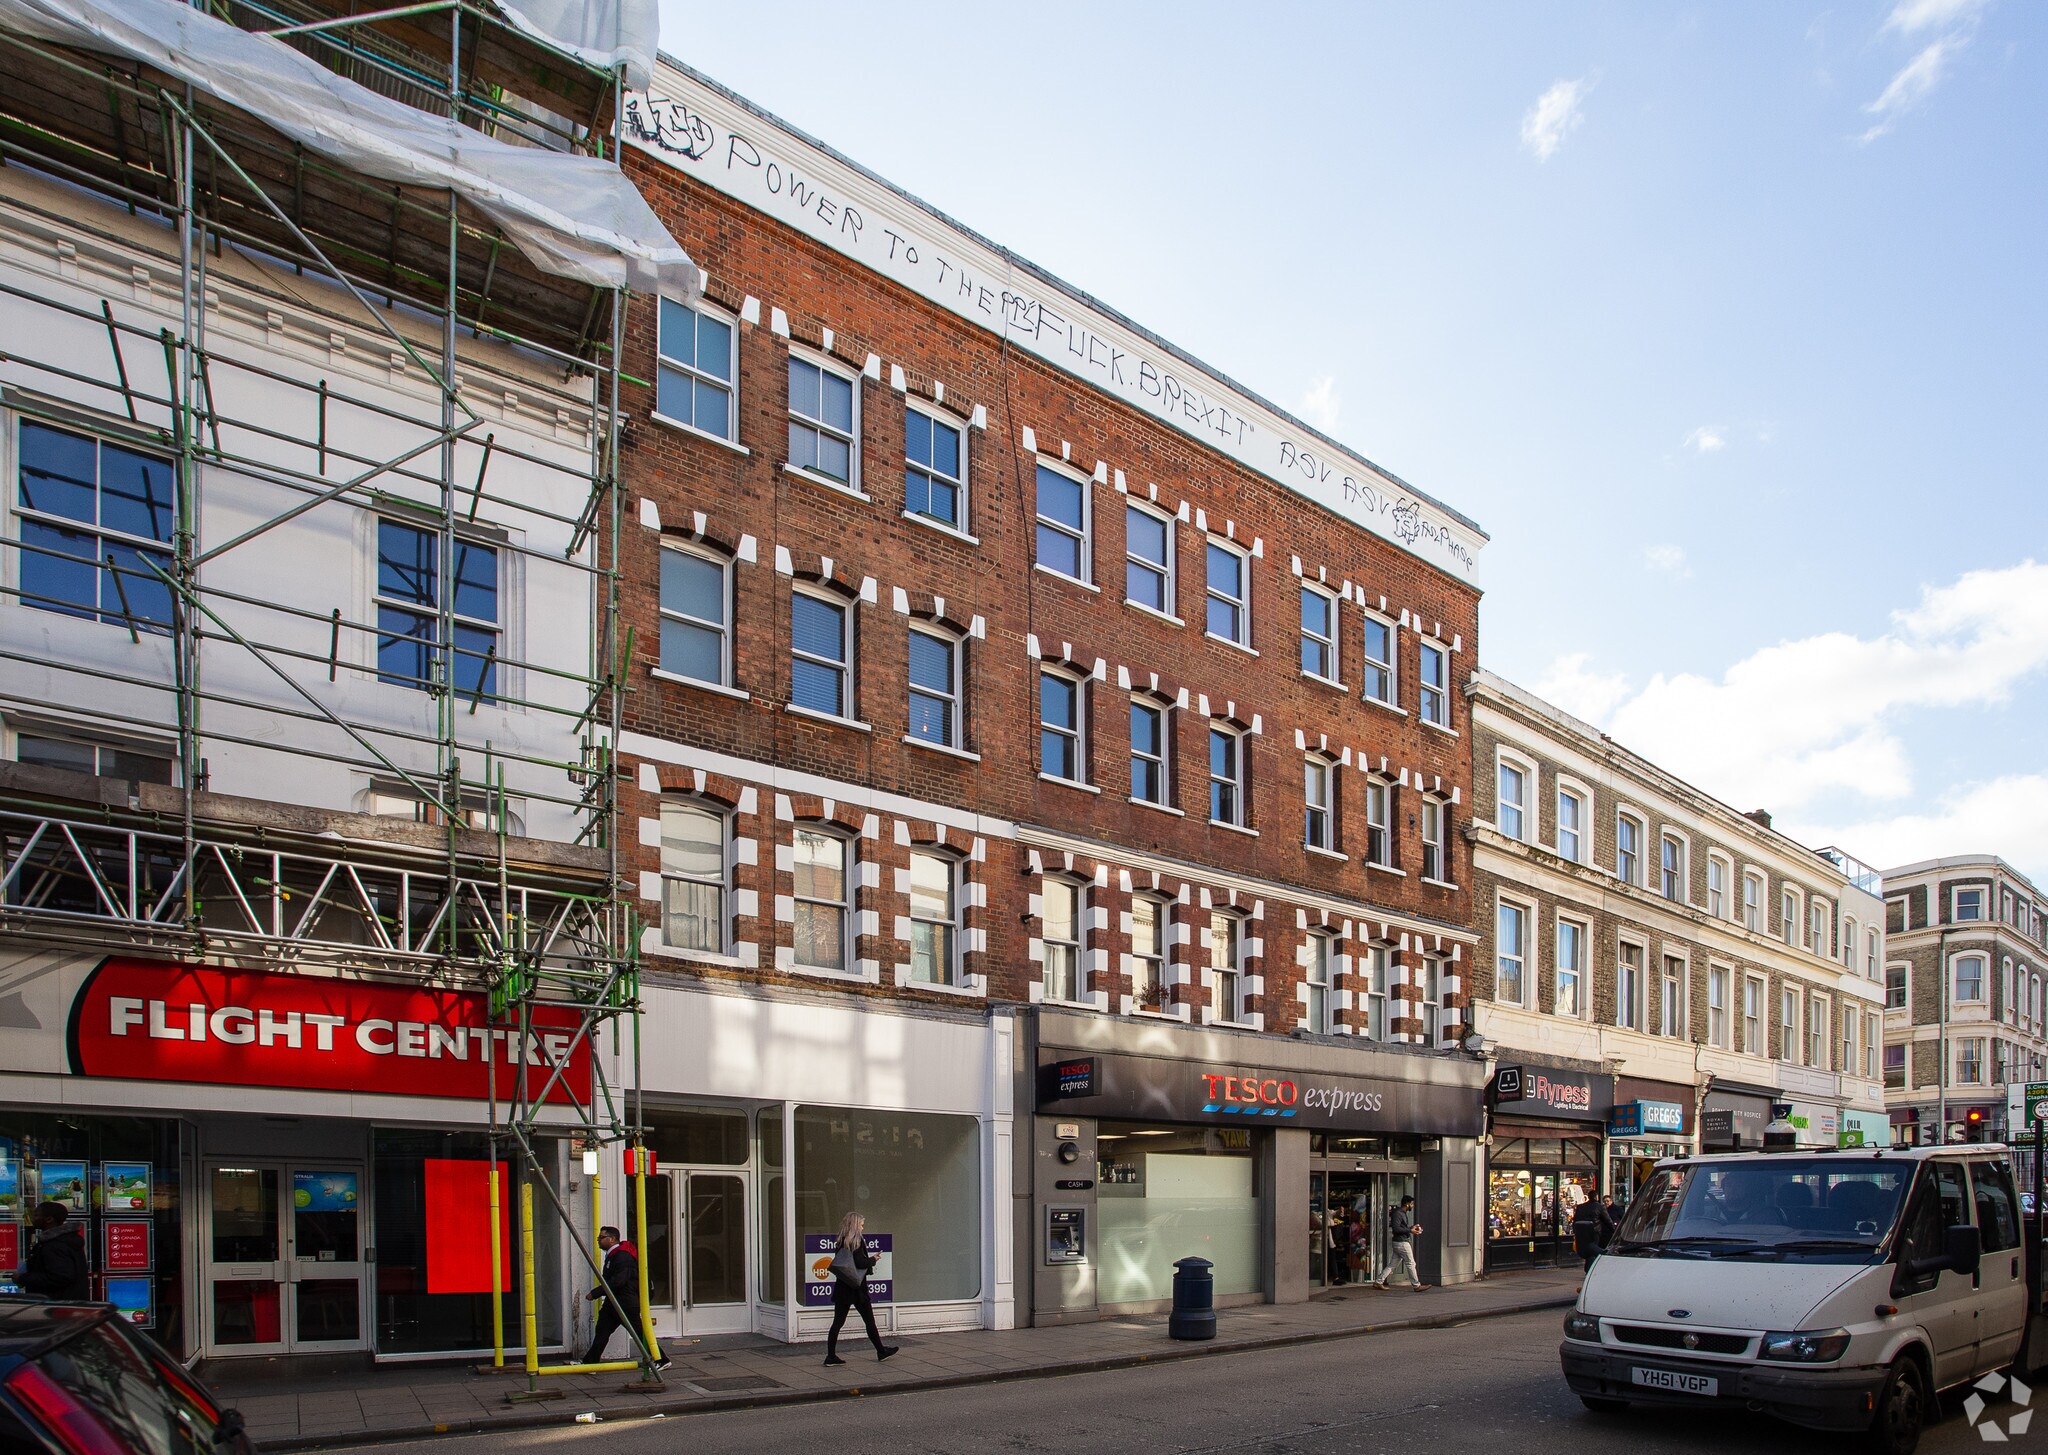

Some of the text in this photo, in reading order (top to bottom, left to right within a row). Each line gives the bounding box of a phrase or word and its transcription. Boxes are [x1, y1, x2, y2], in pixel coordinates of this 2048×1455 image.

[727, 134, 863, 243] POWER
[884, 229, 919, 264] TO
[936, 256, 995, 315] THE
[110, 996, 571, 1069] FLIGHT CENTRE
[1060, 1064, 1090, 1076] TESCO
[1060, 1080, 1089, 1093] express
[1202, 1074, 1383, 1117] TESCO express
[1537, 1076, 1590, 1106] Ryness
[1647, 1106, 1681, 1125] GREGGS
[1611, 1126, 1638, 1134] GREGGS
[819, 1238, 837, 1250] Sho
[811, 1283, 887, 1296] 020 399
[1641, 1369, 1709, 1391] YH51 VGP
